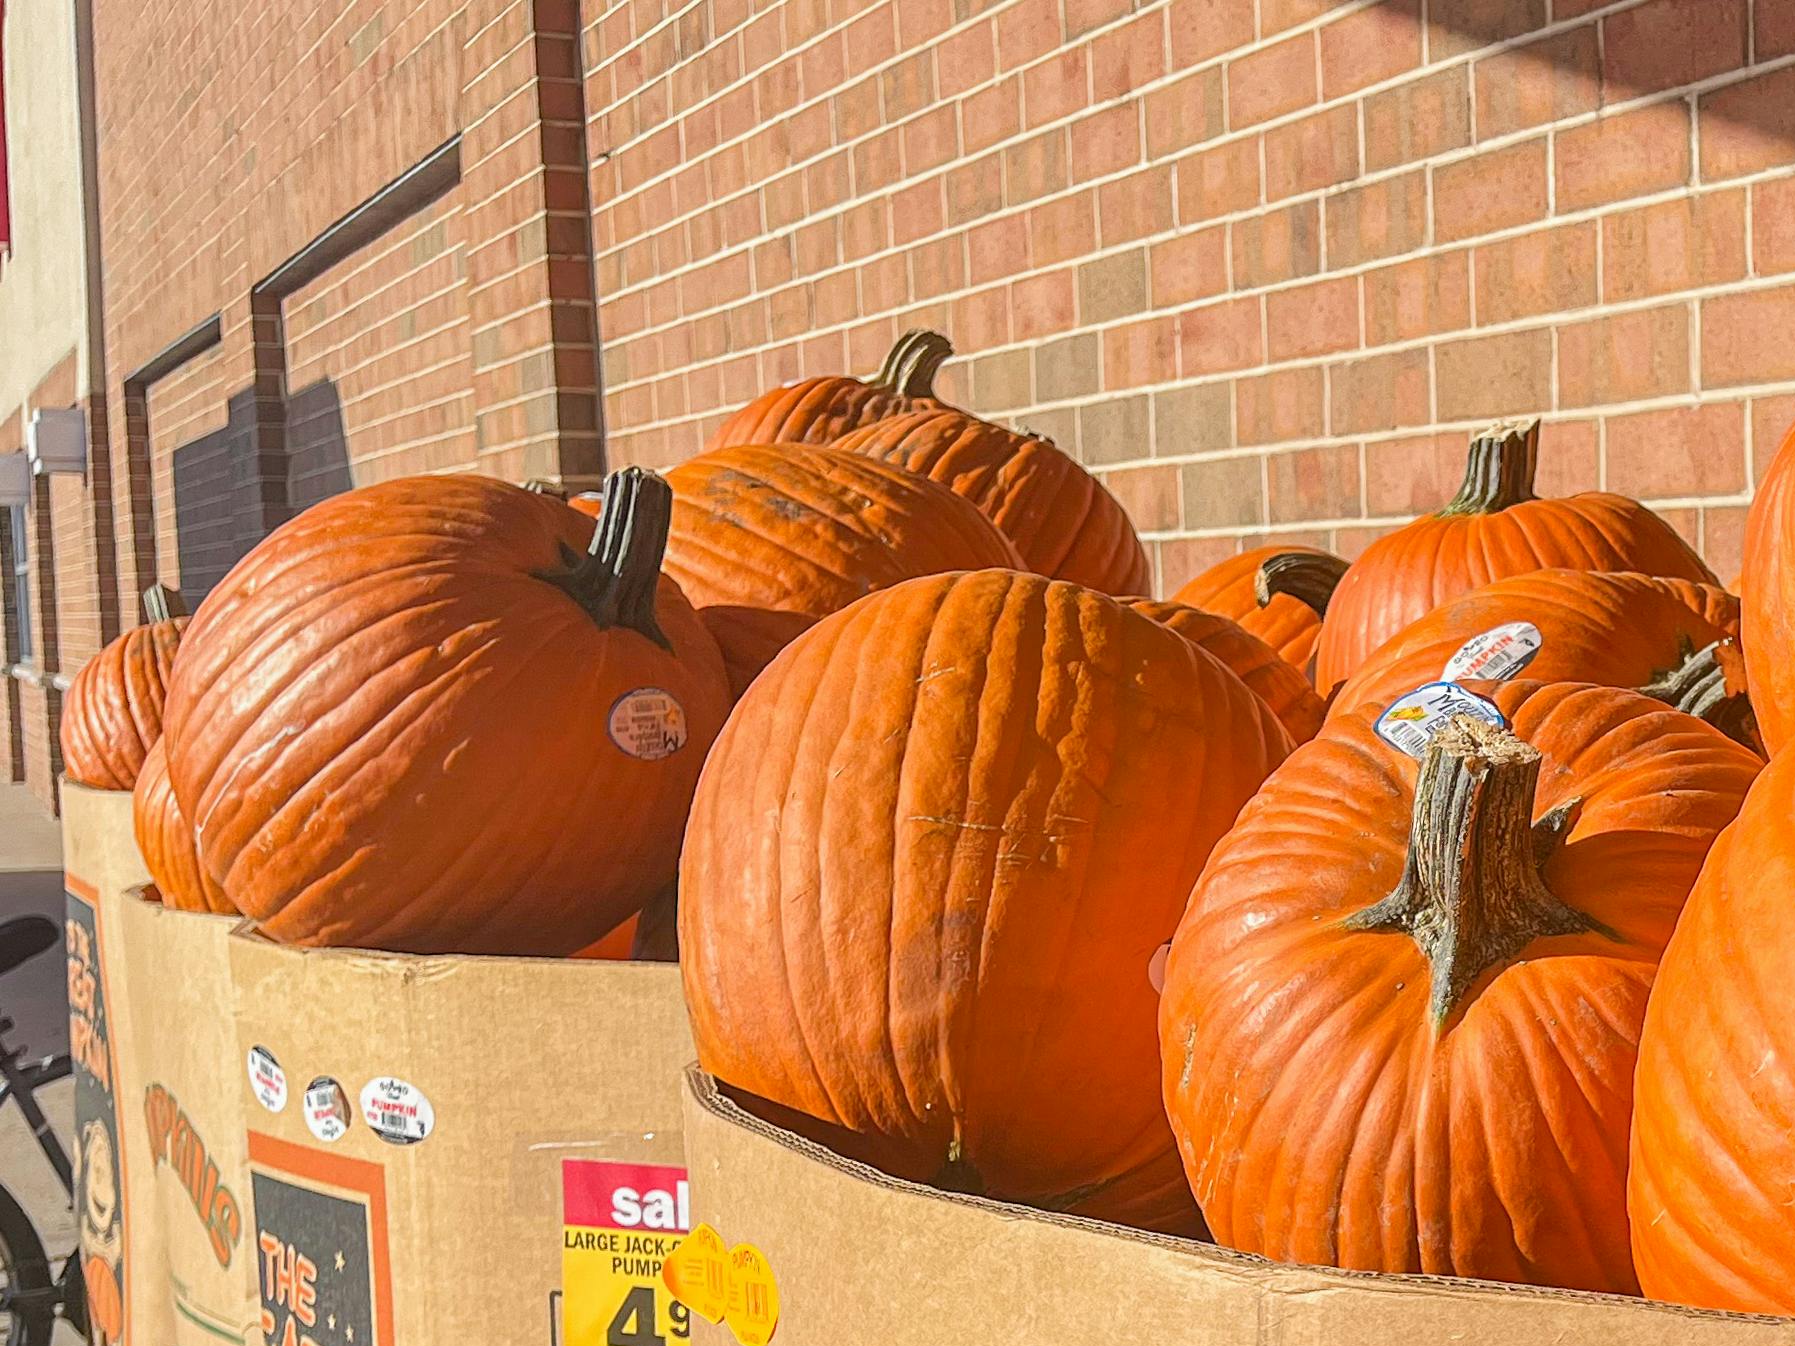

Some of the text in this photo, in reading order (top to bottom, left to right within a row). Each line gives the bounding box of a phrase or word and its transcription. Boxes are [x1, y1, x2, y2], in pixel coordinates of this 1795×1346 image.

[611, 1180, 689, 1231] sal
[564, 1231, 619, 1253] LARGE
[260, 1229, 317, 1327] THE
[612, 1257, 662, 1278] PUMP
